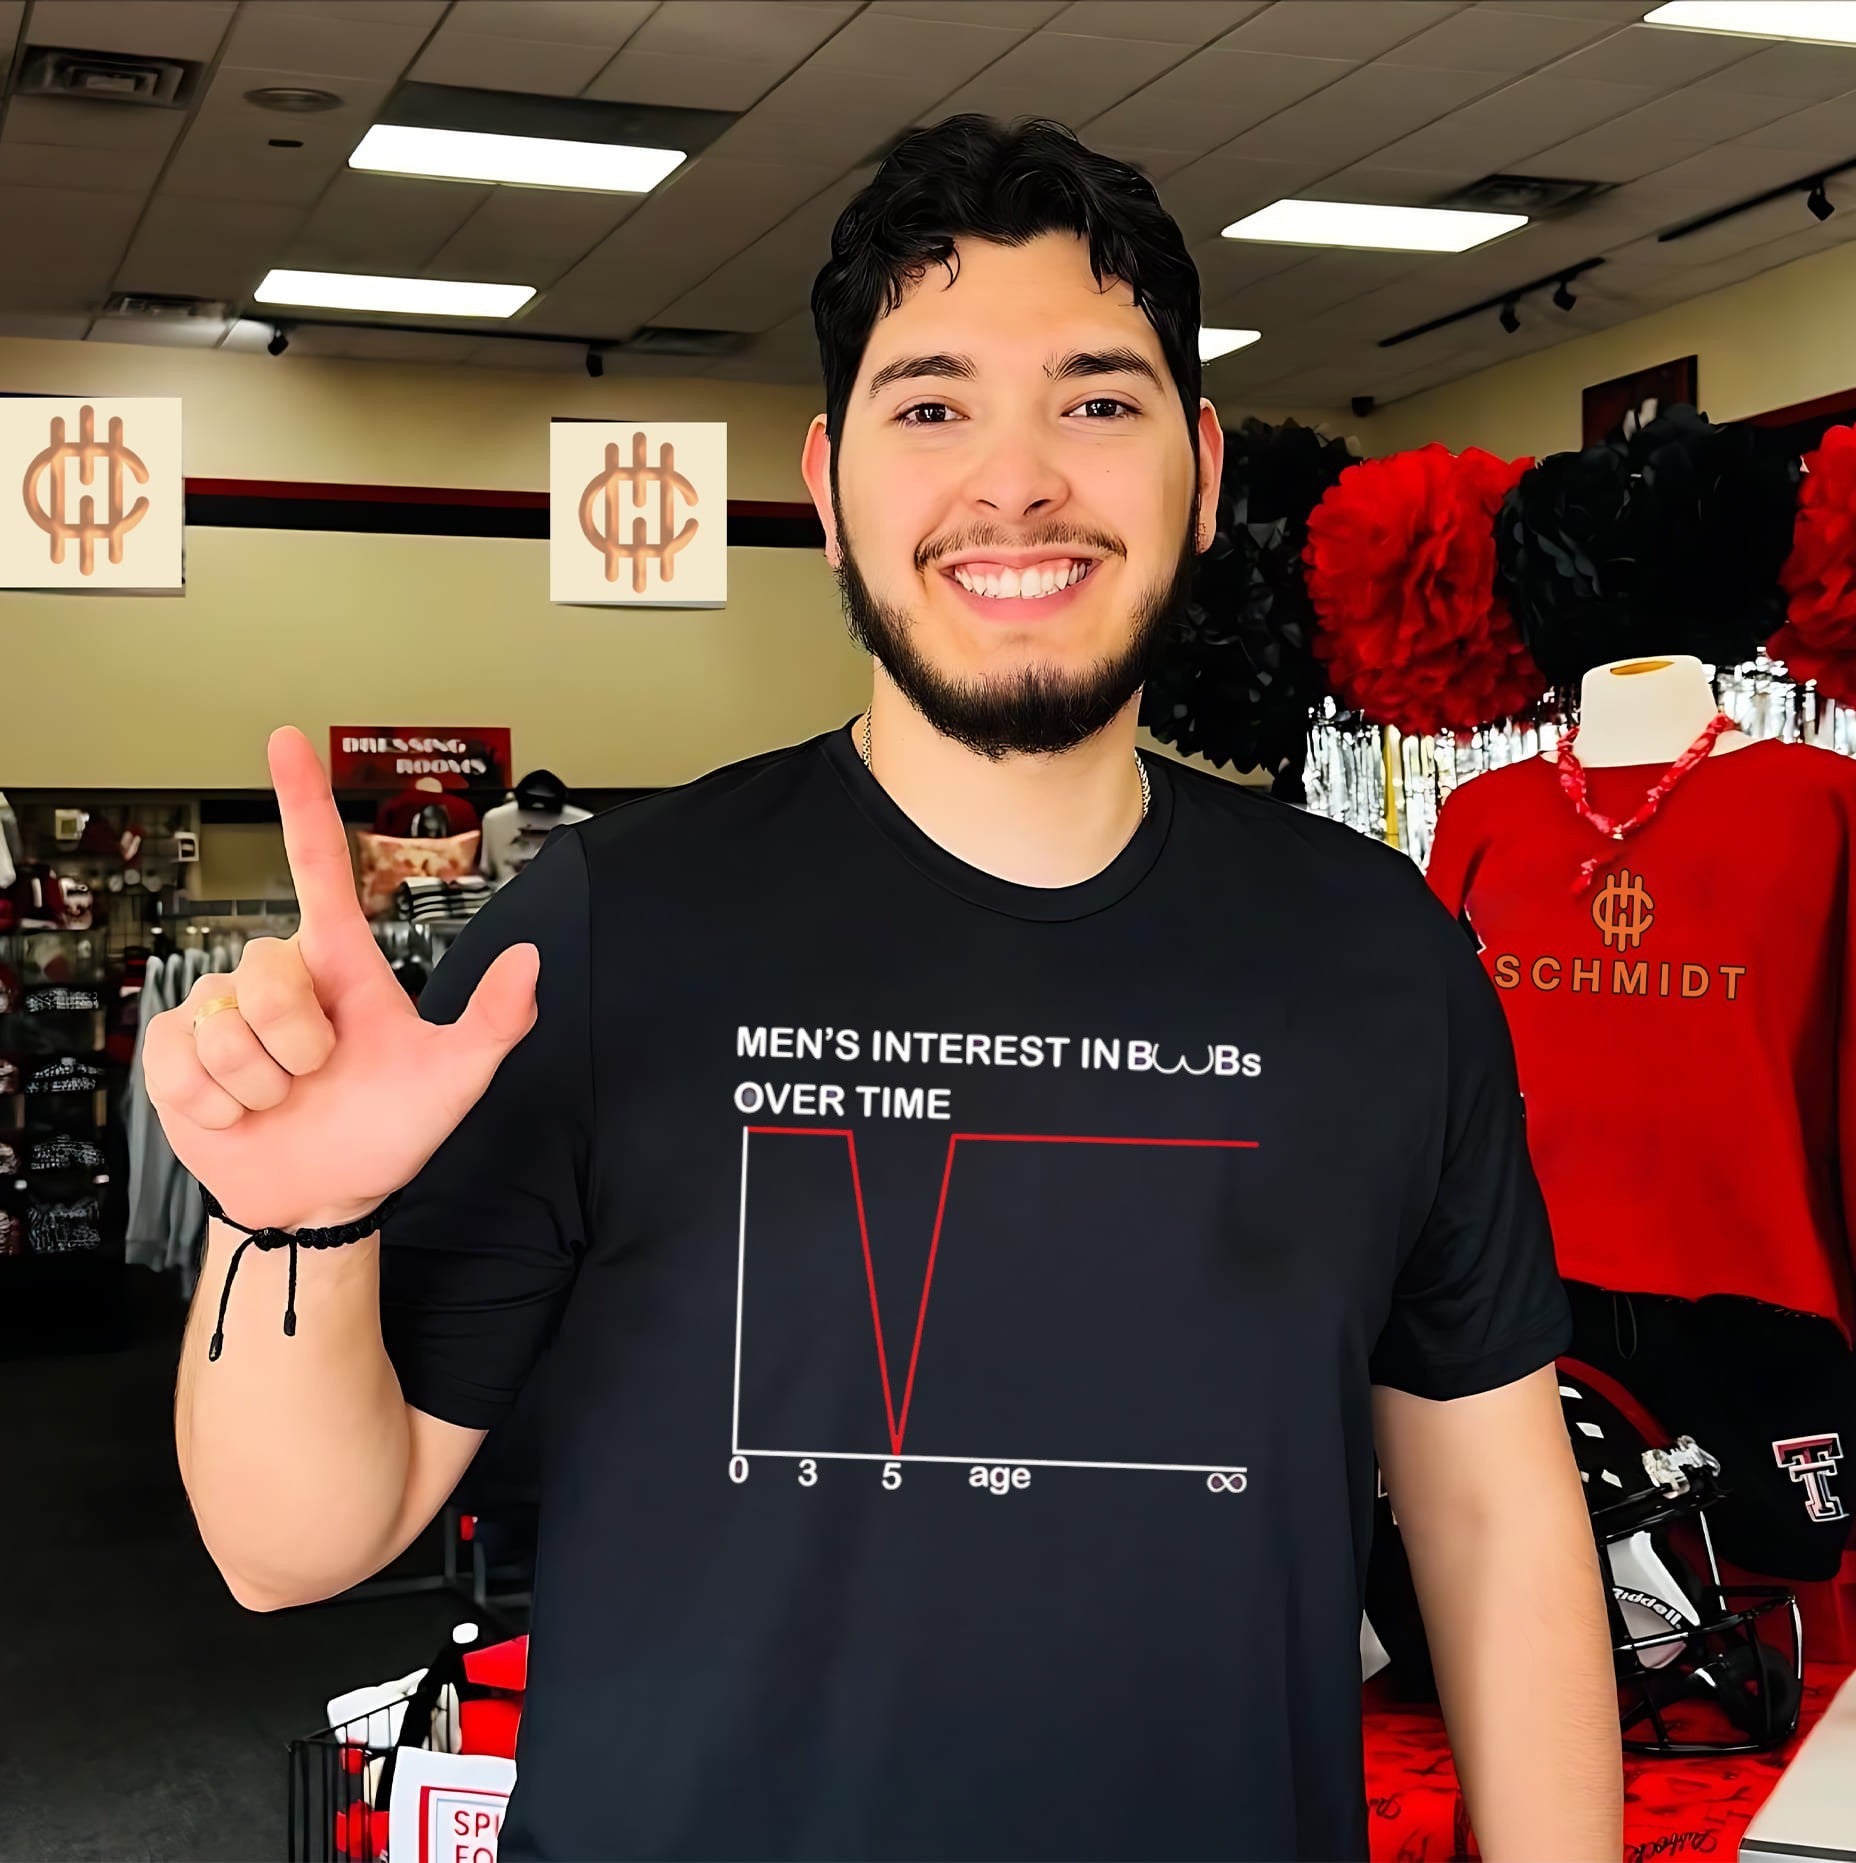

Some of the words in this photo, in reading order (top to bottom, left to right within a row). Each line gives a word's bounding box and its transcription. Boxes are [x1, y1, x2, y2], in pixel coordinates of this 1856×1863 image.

[342, 737, 467, 754] DRESSING
[396, 758, 487, 775] ROOMS
[1494, 954, 1747, 1000] SCHMIDT
[736, 1025, 861, 1060] MEN’S
[872, 1029, 1071, 1067] INTEREST
[1081, 1037, 1121, 1070] IN
[733, 1081, 845, 1117] OVER
[855, 1085, 952, 1120] TIME
[729, 1455, 749, 1484] 0
[797, 1458, 819, 1488] 3
[881, 1461, 903, 1491] 5
[968, 1465, 1032, 1496] age
